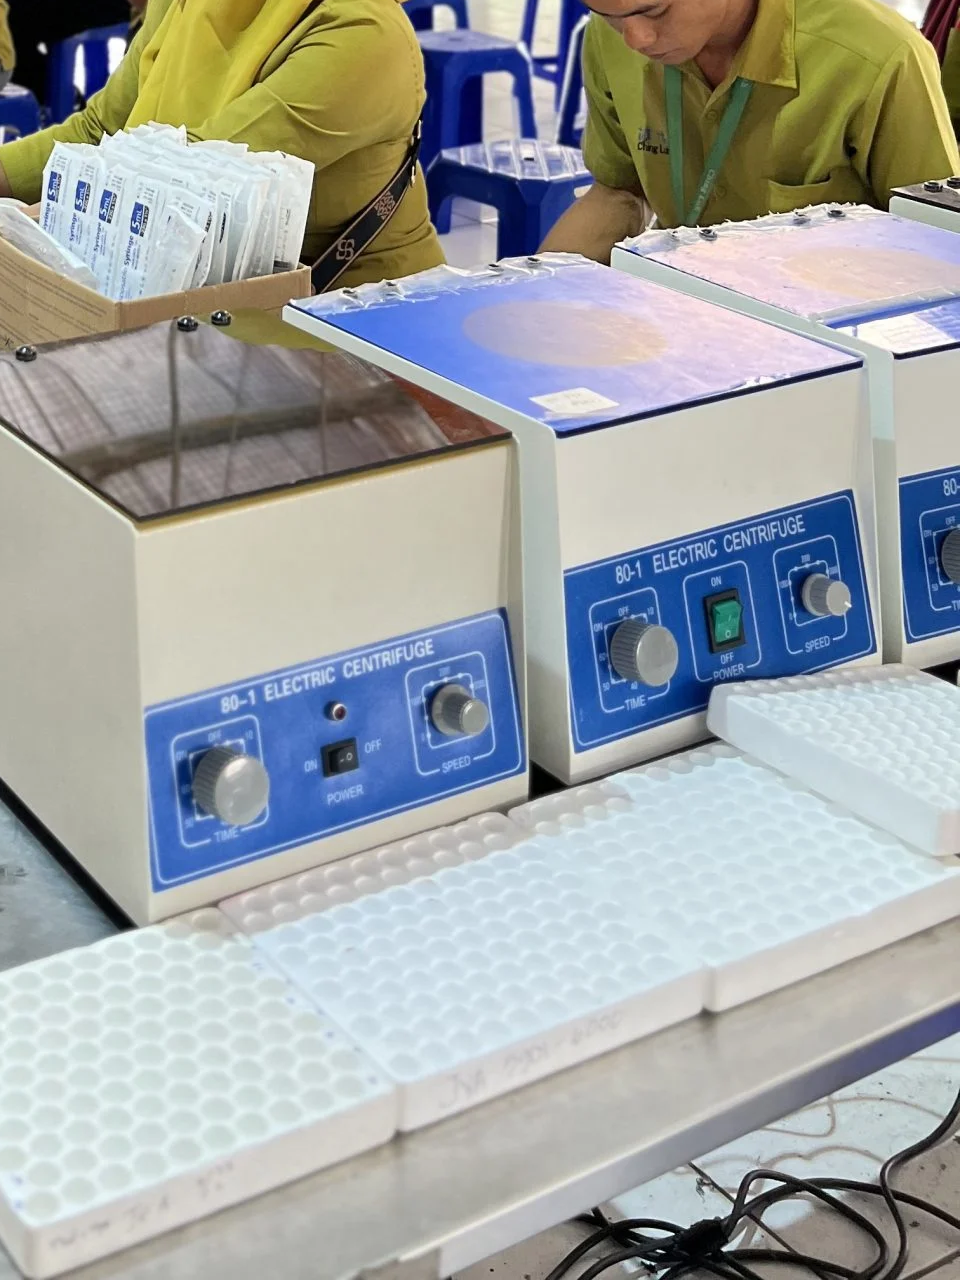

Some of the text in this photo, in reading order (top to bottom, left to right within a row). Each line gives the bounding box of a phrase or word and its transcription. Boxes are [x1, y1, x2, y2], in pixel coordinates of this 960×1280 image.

[69, 212, 77, 241] Syringe
[93, 222, 102, 252] Syringe
[124, 235, 134, 266] Syringe
[615, 514, 806, 585] 80-1 ELECTRIC CENTRIFUGE
[710, 576, 722, 587] ON
[618, 606, 630, 617] OFF
[593, 622, 604, 633] ON
[804, 635, 831, 653] SPEED
[720, 652, 734, 665] OFF
[221, 638, 435, 715] 80-1 ELECTRIC CENTRIFUGE
[713, 663, 745, 681] POWER
[624, 694, 646, 711] TIME
[208, 730, 222, 742] OFF
[364, 738, 382, 754] OFF
[304, 759, 318, 772] ON
[442, 755, 471, 773] SPEED
[326, 784, 364, 805] POWER
[213, 826, 240, 842] TIME
